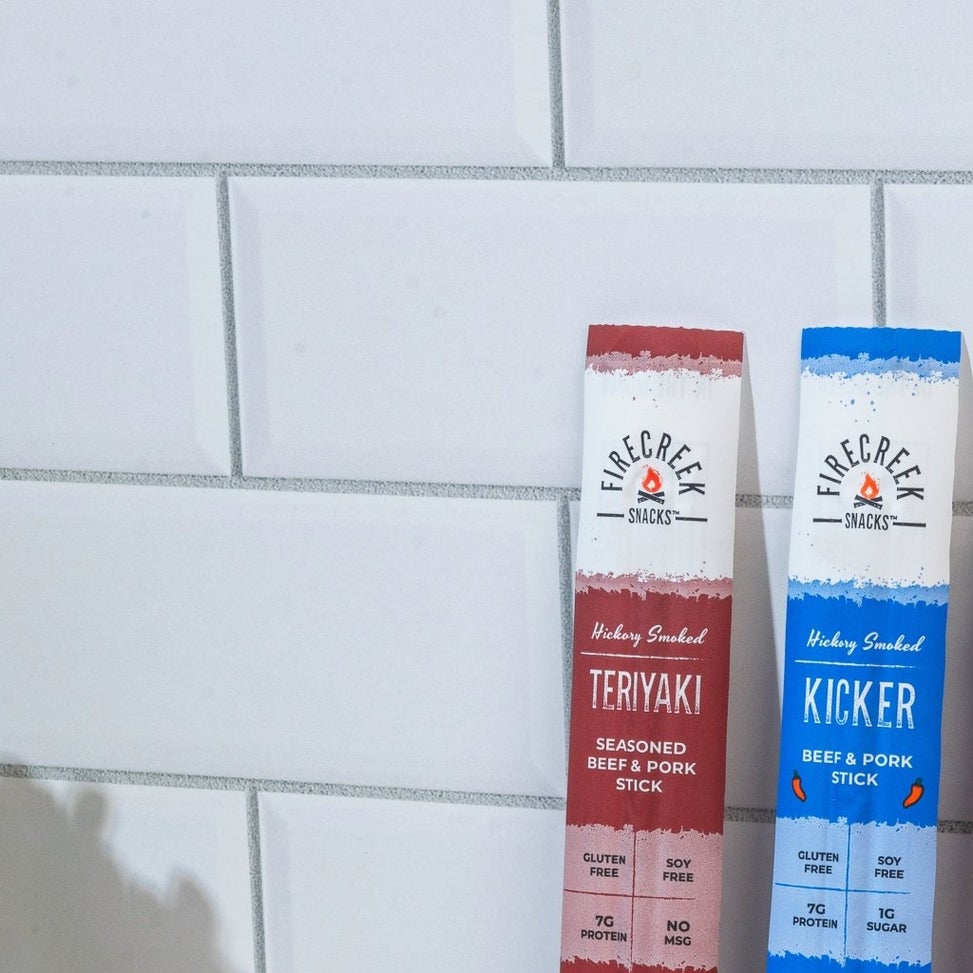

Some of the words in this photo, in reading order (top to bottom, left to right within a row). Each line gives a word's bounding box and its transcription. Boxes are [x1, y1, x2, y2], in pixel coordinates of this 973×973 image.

[601, 430, 706, 496] FIRECREEK
[817, 433, 924, 500] FIRECREEK
[591, 621, 643, 645] Hickory
[647, 624, 708, 645] Smoked
[806, 629, 857, 653] Hickory
[862, 631, 925, 653] Smoked
[590, 669, 702, 715] TERIYAKI
[803, 677, 915, 729] KICKER
[596, 738, 687, 755] SEASONED
[587, 756, 627, 771] BEEF
[631, 759, 641, 773] &
[647, 760, 697, 775] PORK
[802, 750, 843, 764] BEEF
[845, 752, 856, 766] &
[863, 753, 913, 769] PORK
[831, 771, 879, 786] STICK
[616, 778, 663, 793] STICK
[583, 853, 626, 865] GLUTEN
[798, 850, 839, 862] GLUTEN
[878, 856, 902, 866] SOY
[666, 859, 692, 869] SOY
[804, 864, 833, 874] FREE
[590, 867, 619, 877] FREE
[662, 872, 694, 882] FREE
[874, 869, 905, 879] FREE
[807, 903, 826, 914] 7G
[878, 908, 895, 919] 1G
[595, 915, 614, 927] 7G
[666, 920, 691, 932] NO
[792, 916, 838, 929] PROTEIN
[867, 922, 907, 933] SUGAR
[581, 929, 627, 942] PROTEIN
[664, 936, 692, 946] MSG
